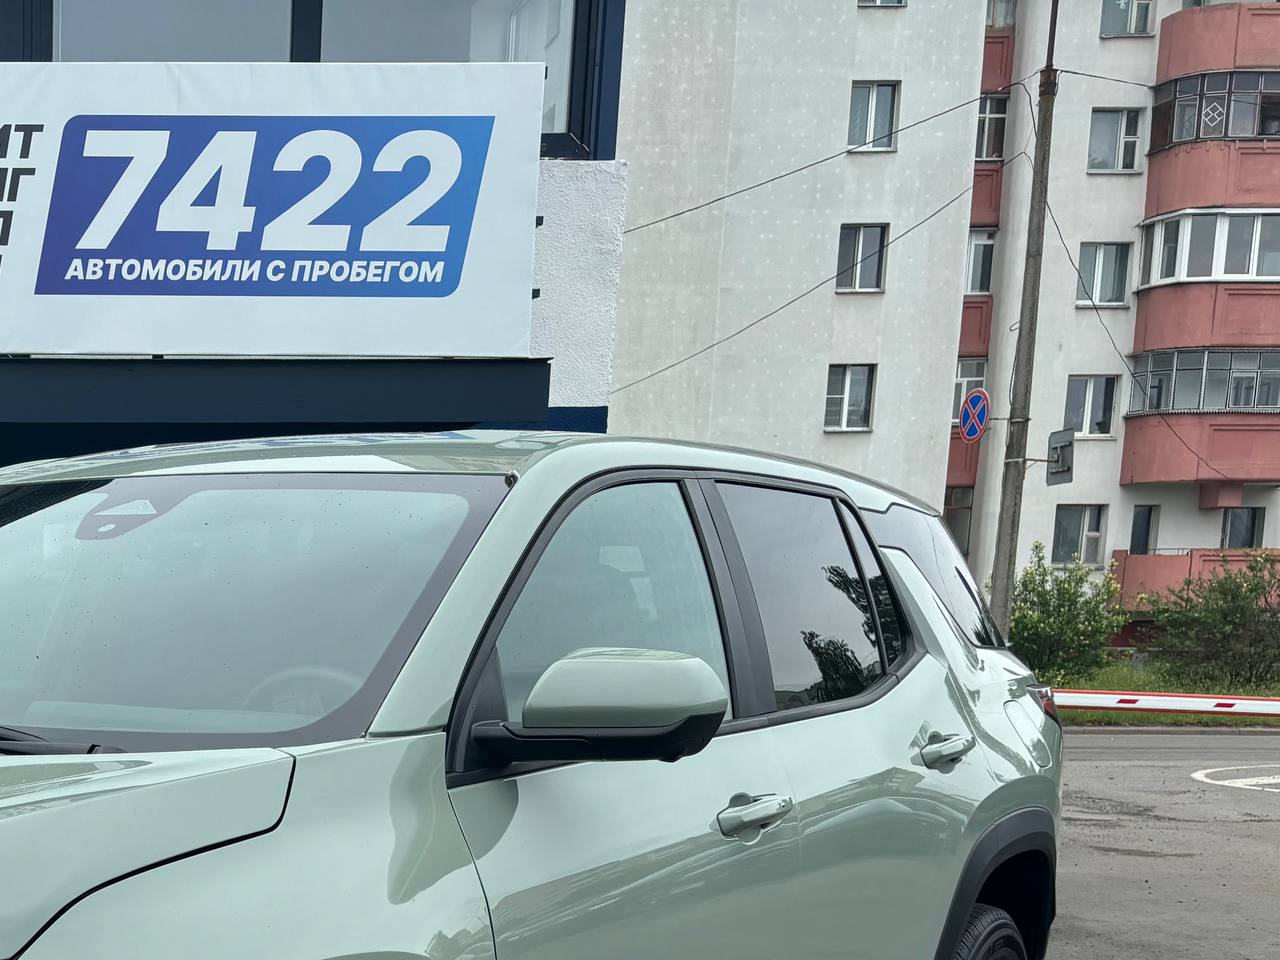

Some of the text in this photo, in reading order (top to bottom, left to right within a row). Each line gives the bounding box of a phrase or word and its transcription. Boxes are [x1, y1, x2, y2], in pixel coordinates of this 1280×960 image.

[75, 129, 462, 252] 7422
[65, 258, 445, 283] АВТОМОБИЛИ С ПРОБЕГОМ
